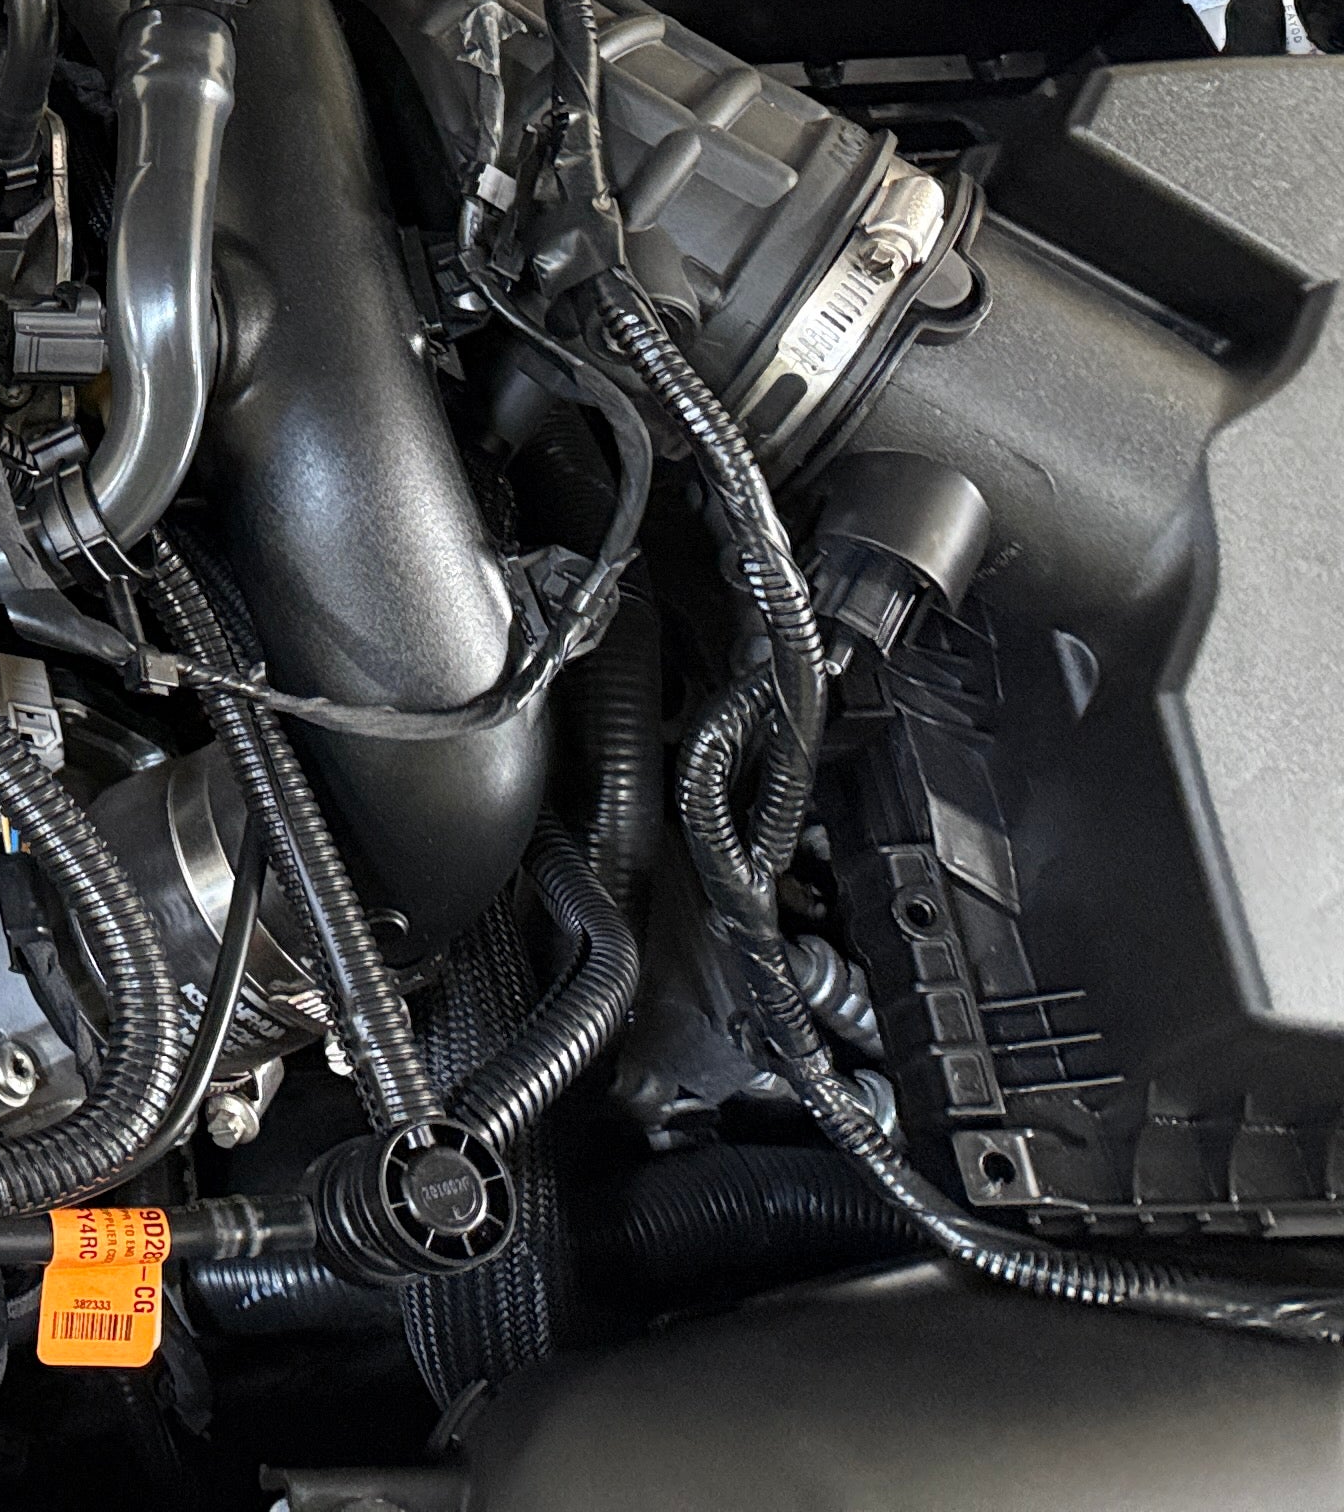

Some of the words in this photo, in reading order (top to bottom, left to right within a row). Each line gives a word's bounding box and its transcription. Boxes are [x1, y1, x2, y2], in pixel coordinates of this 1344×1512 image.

[76, 1208, 98, 1260] Y4RC
[100, 1209, 118, 1246] PPLIER
[124, 1224, 134, 1236] TO
[124, 1240, 135, 1257] ENG
[73, 1299, 111, 1310] 382333
